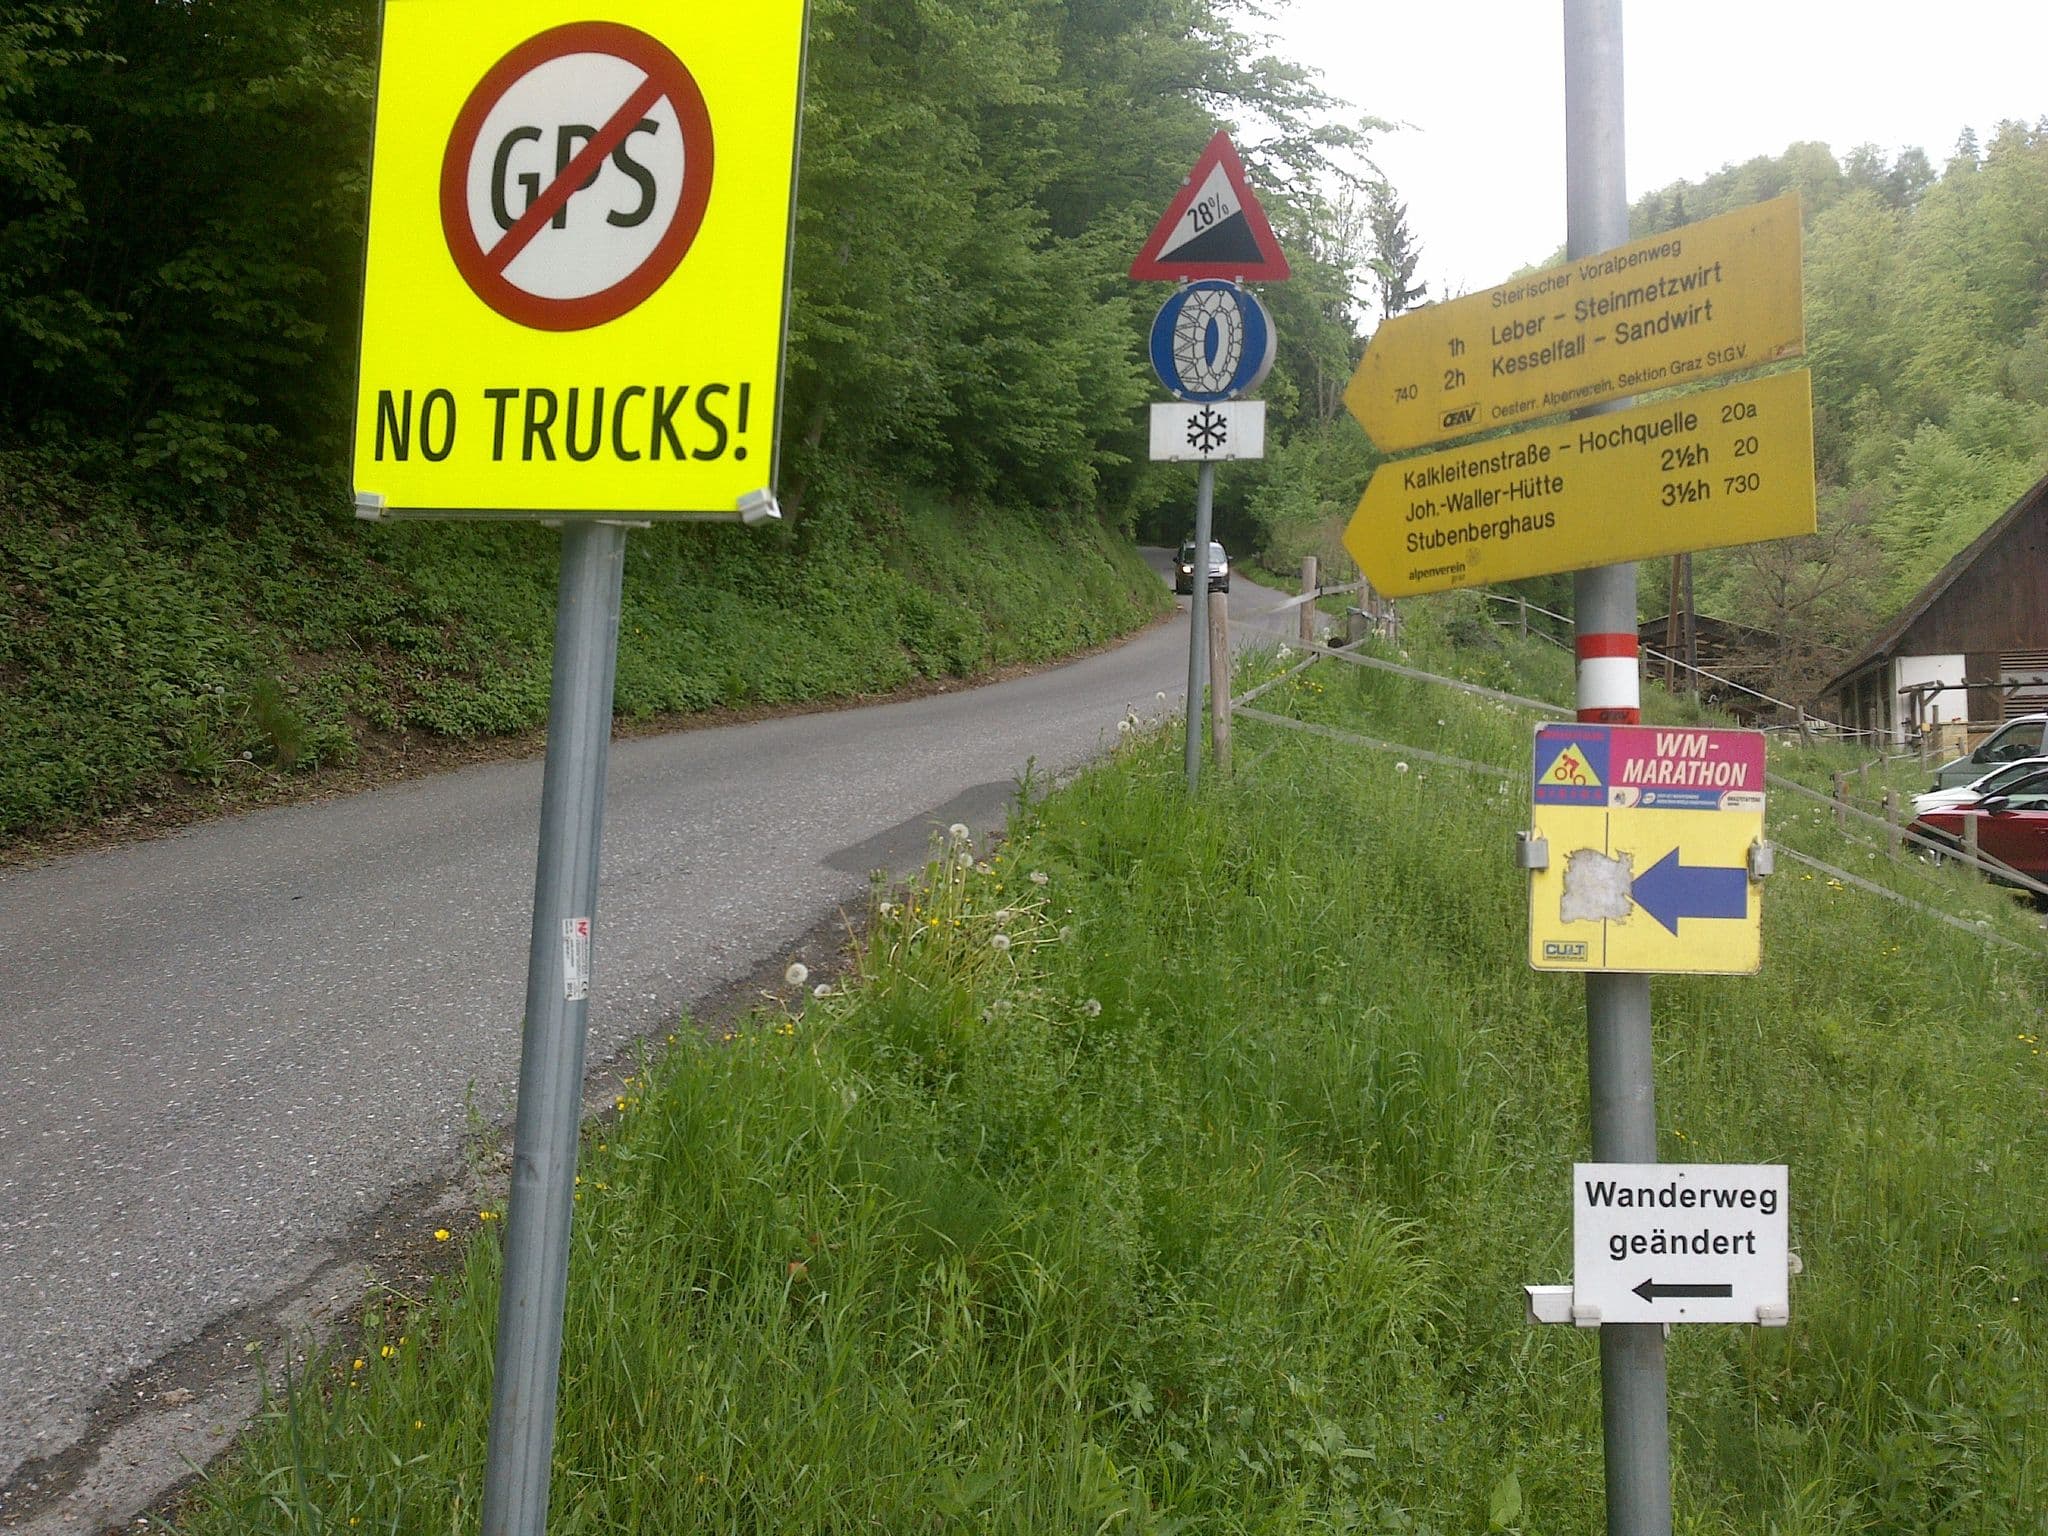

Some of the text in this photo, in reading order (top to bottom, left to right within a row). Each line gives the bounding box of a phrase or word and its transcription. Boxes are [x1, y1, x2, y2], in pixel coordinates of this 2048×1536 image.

[491, 117, 660, 230] GPS
[1187, 193, 1229, 232] 28%
[1492, 240, 1682, 308] Steirischer Voralpenweg
[1448, 338, 1465, 357] 1h
[1492, 315, 1545, 346] Leber
[1575, 261, 1722, 321] Steinmetzwirt
[1394, 384, 1418, 404] 740
[1444, 368, 1465, 390] 2h
[1492, 334, 1585, 377] Kesselfall
[1615, 299, 1712, 345] Sandwirt
[1618, 367, 1667, 389] Sektion
[1670, 357, 1702, 375] Graz
[374, 382, 751, 462] NO TRUCKS!
[1403, 443, 1550, 491] Kalkleitenstraße
[1579, 411, 1698, 454] Hochquelle
[1721, 402, 1757, 424] 20a
[1405, 436, 1759, 522] Joh.-Waller-Hütte 2½h 20
[1406, 473, 1760, 553] Stubenberghaus 3½h 730
[1408, 562, 1466, 583] alpenverein
[1622, 758, 1748, 787] MARATHON
[1656, 732, 1720, 759] WM-
[1585, 1181, 1778, 1215] Wanderweg
[1609, 1228, 1756, 1261] geändert
